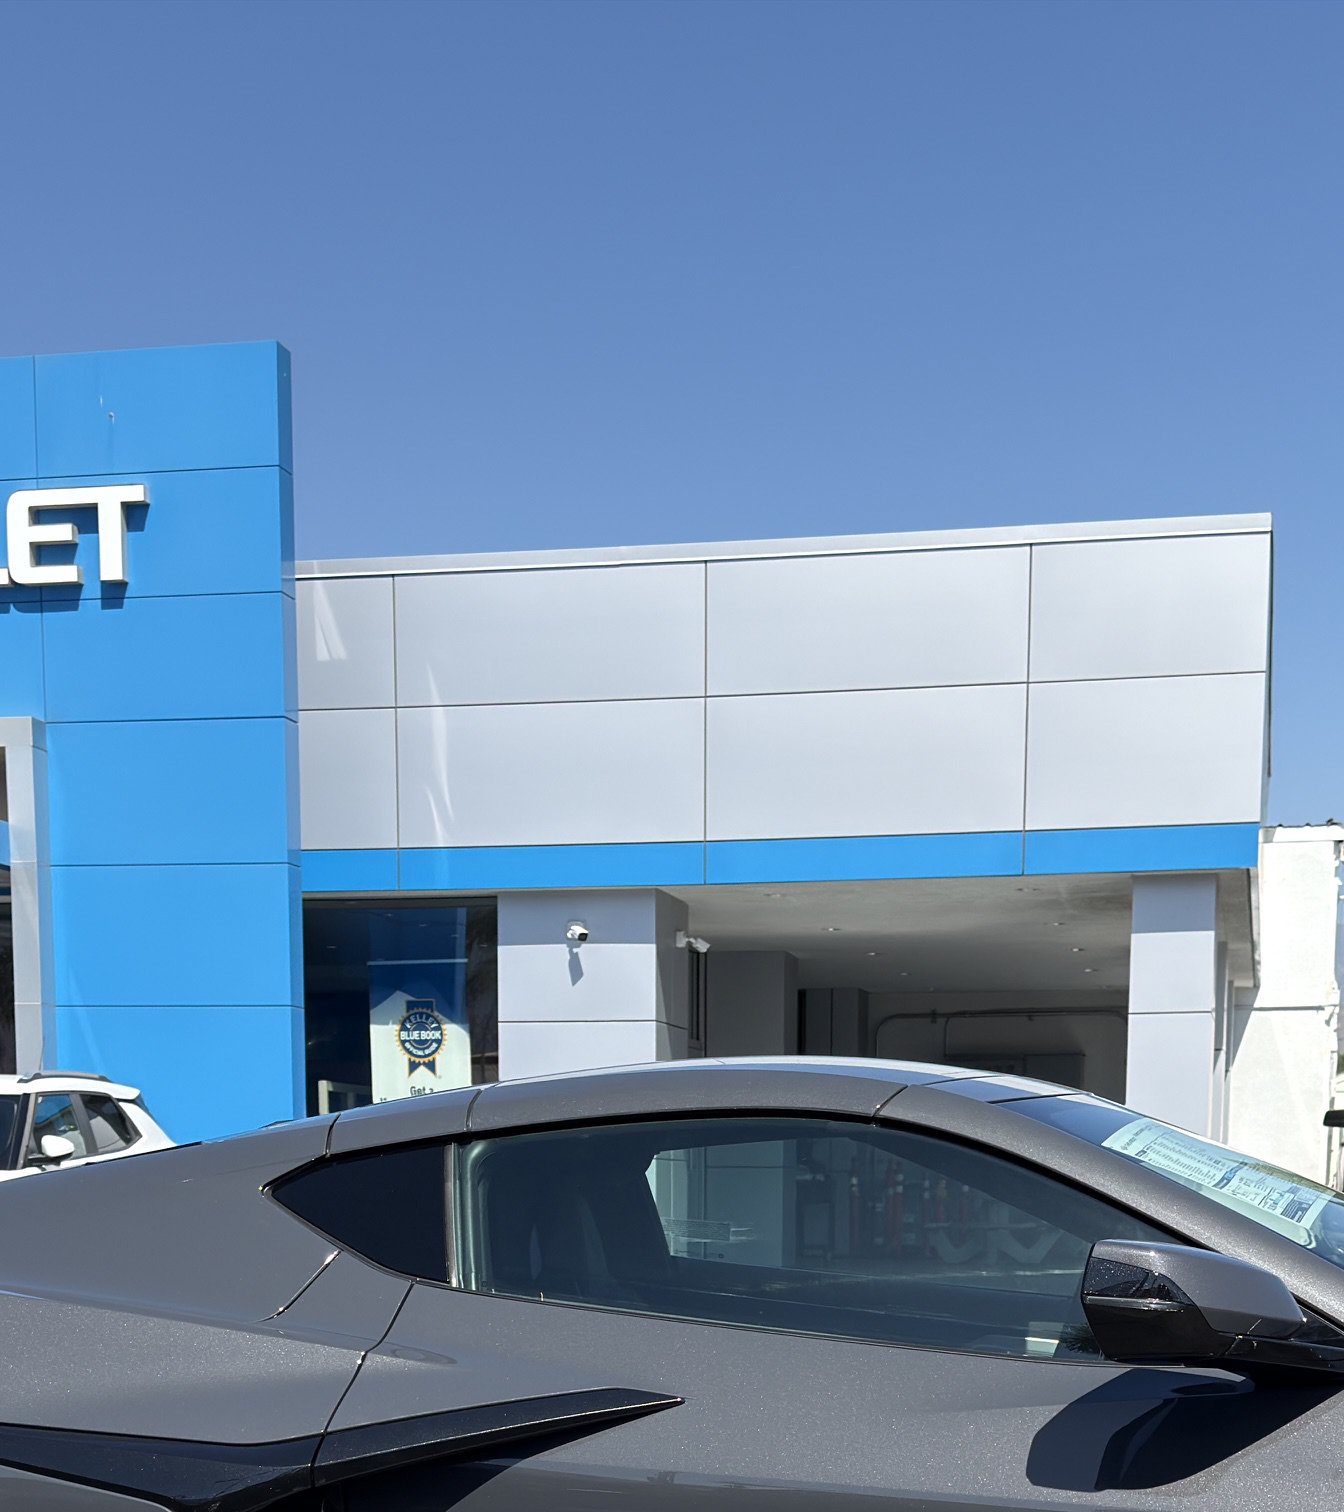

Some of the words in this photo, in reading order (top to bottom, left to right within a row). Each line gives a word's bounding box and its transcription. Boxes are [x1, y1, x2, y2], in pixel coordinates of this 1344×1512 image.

[404, 1013, 439, 1029] KELLEY
[400, 1030, 420, 1040] BLUE
[421, 1030, 442, 1040] BOOK
